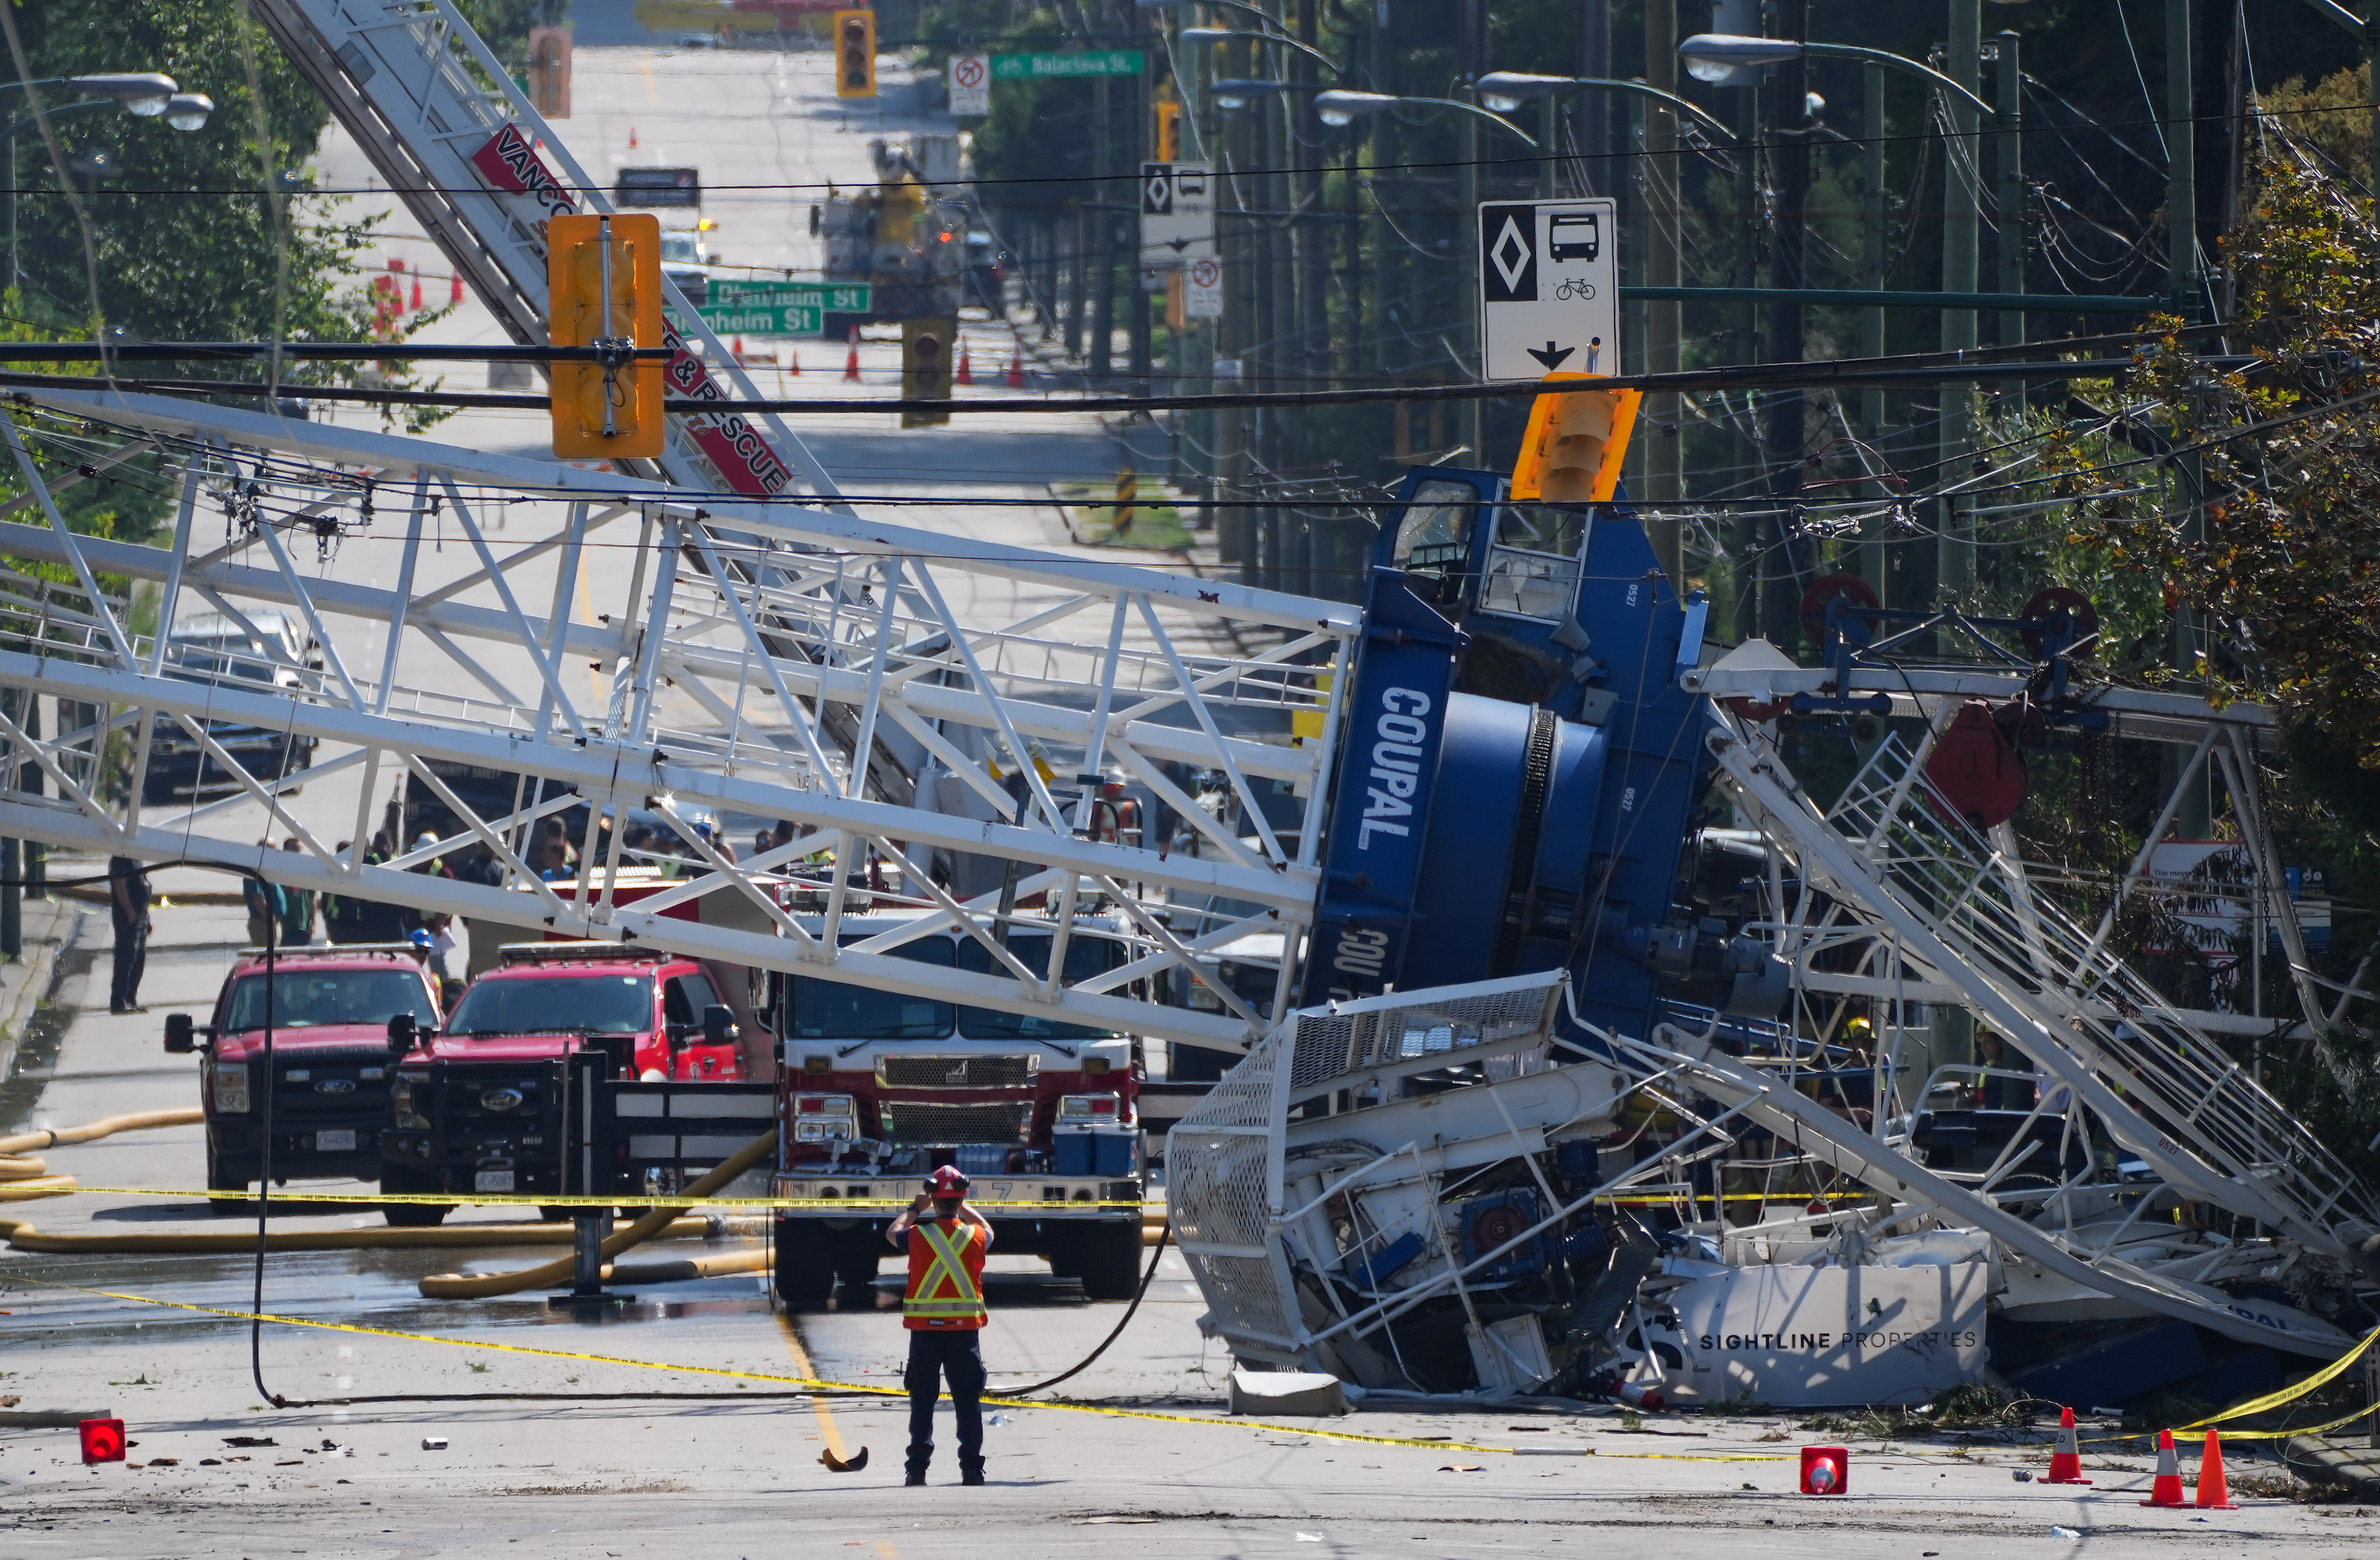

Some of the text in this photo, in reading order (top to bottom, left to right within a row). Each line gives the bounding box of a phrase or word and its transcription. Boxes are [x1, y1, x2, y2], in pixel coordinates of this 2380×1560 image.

[667, 308, 811, 331] Blnheim St
[673, 356, 697, 386] &
[691, 379, 786, 495] RSCUE
[1626, 584, 1638, 607] 0527
[1358, 687, 1431, 850] COUPAL
[1622, 788, 1635, 812] 0527
[992, 1183, 1012, 1213] 7
[1700, 1331, 1976, 1350] SIGHTLINE PROPERTIES
